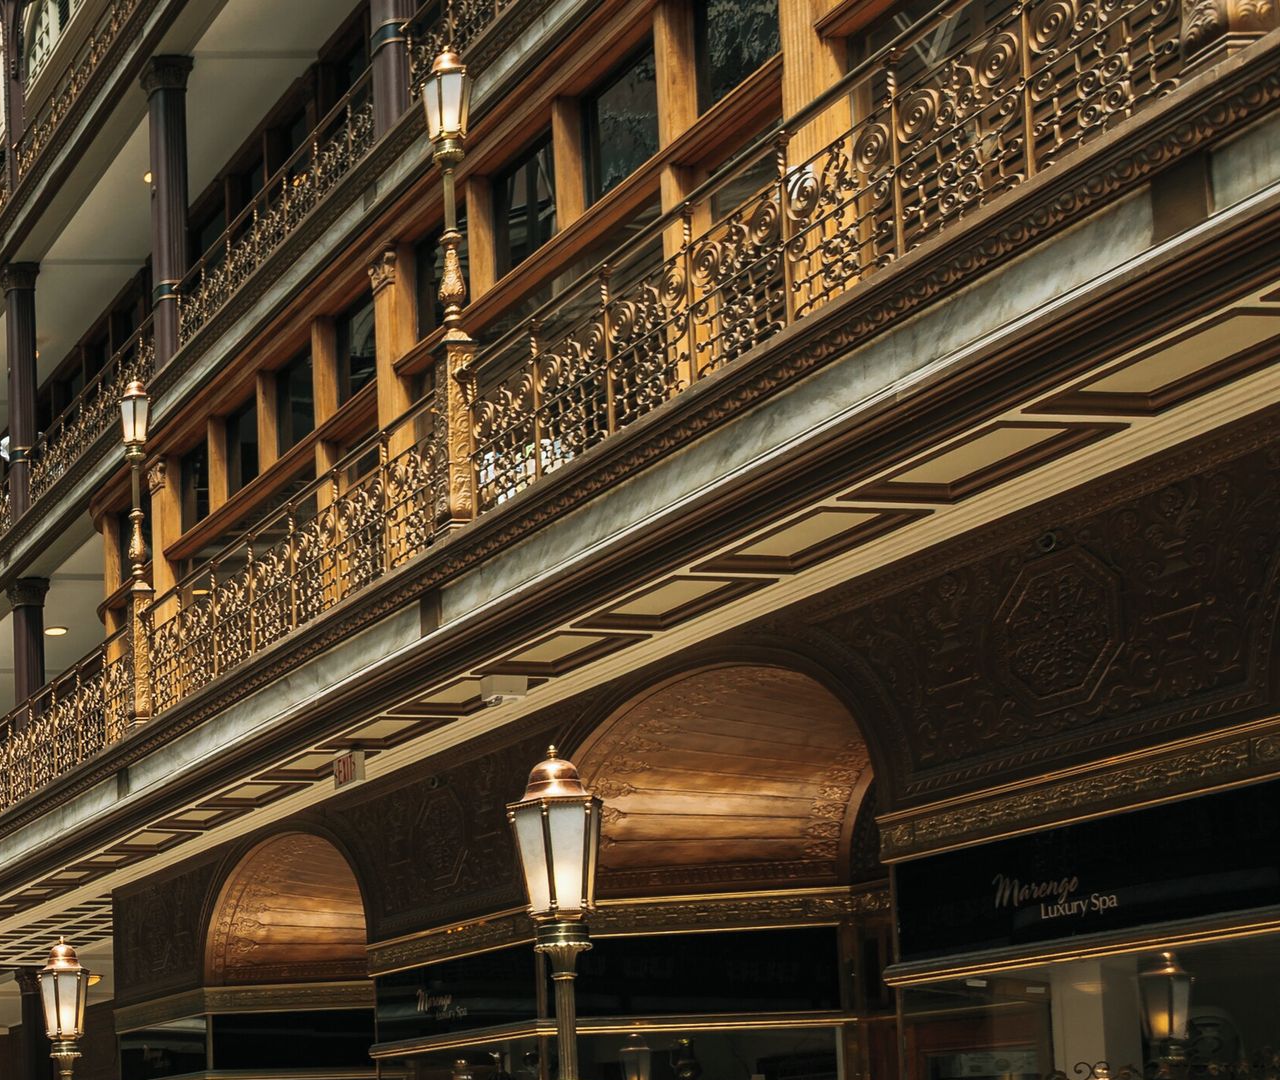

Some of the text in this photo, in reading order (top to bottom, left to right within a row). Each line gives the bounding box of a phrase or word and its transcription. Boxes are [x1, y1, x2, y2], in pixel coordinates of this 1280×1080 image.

[338, 754, 353, 784] EXIT
[991, 873, 1079, 909] Marengo
[1041, 893, 1118, 919] Luxury Spa
